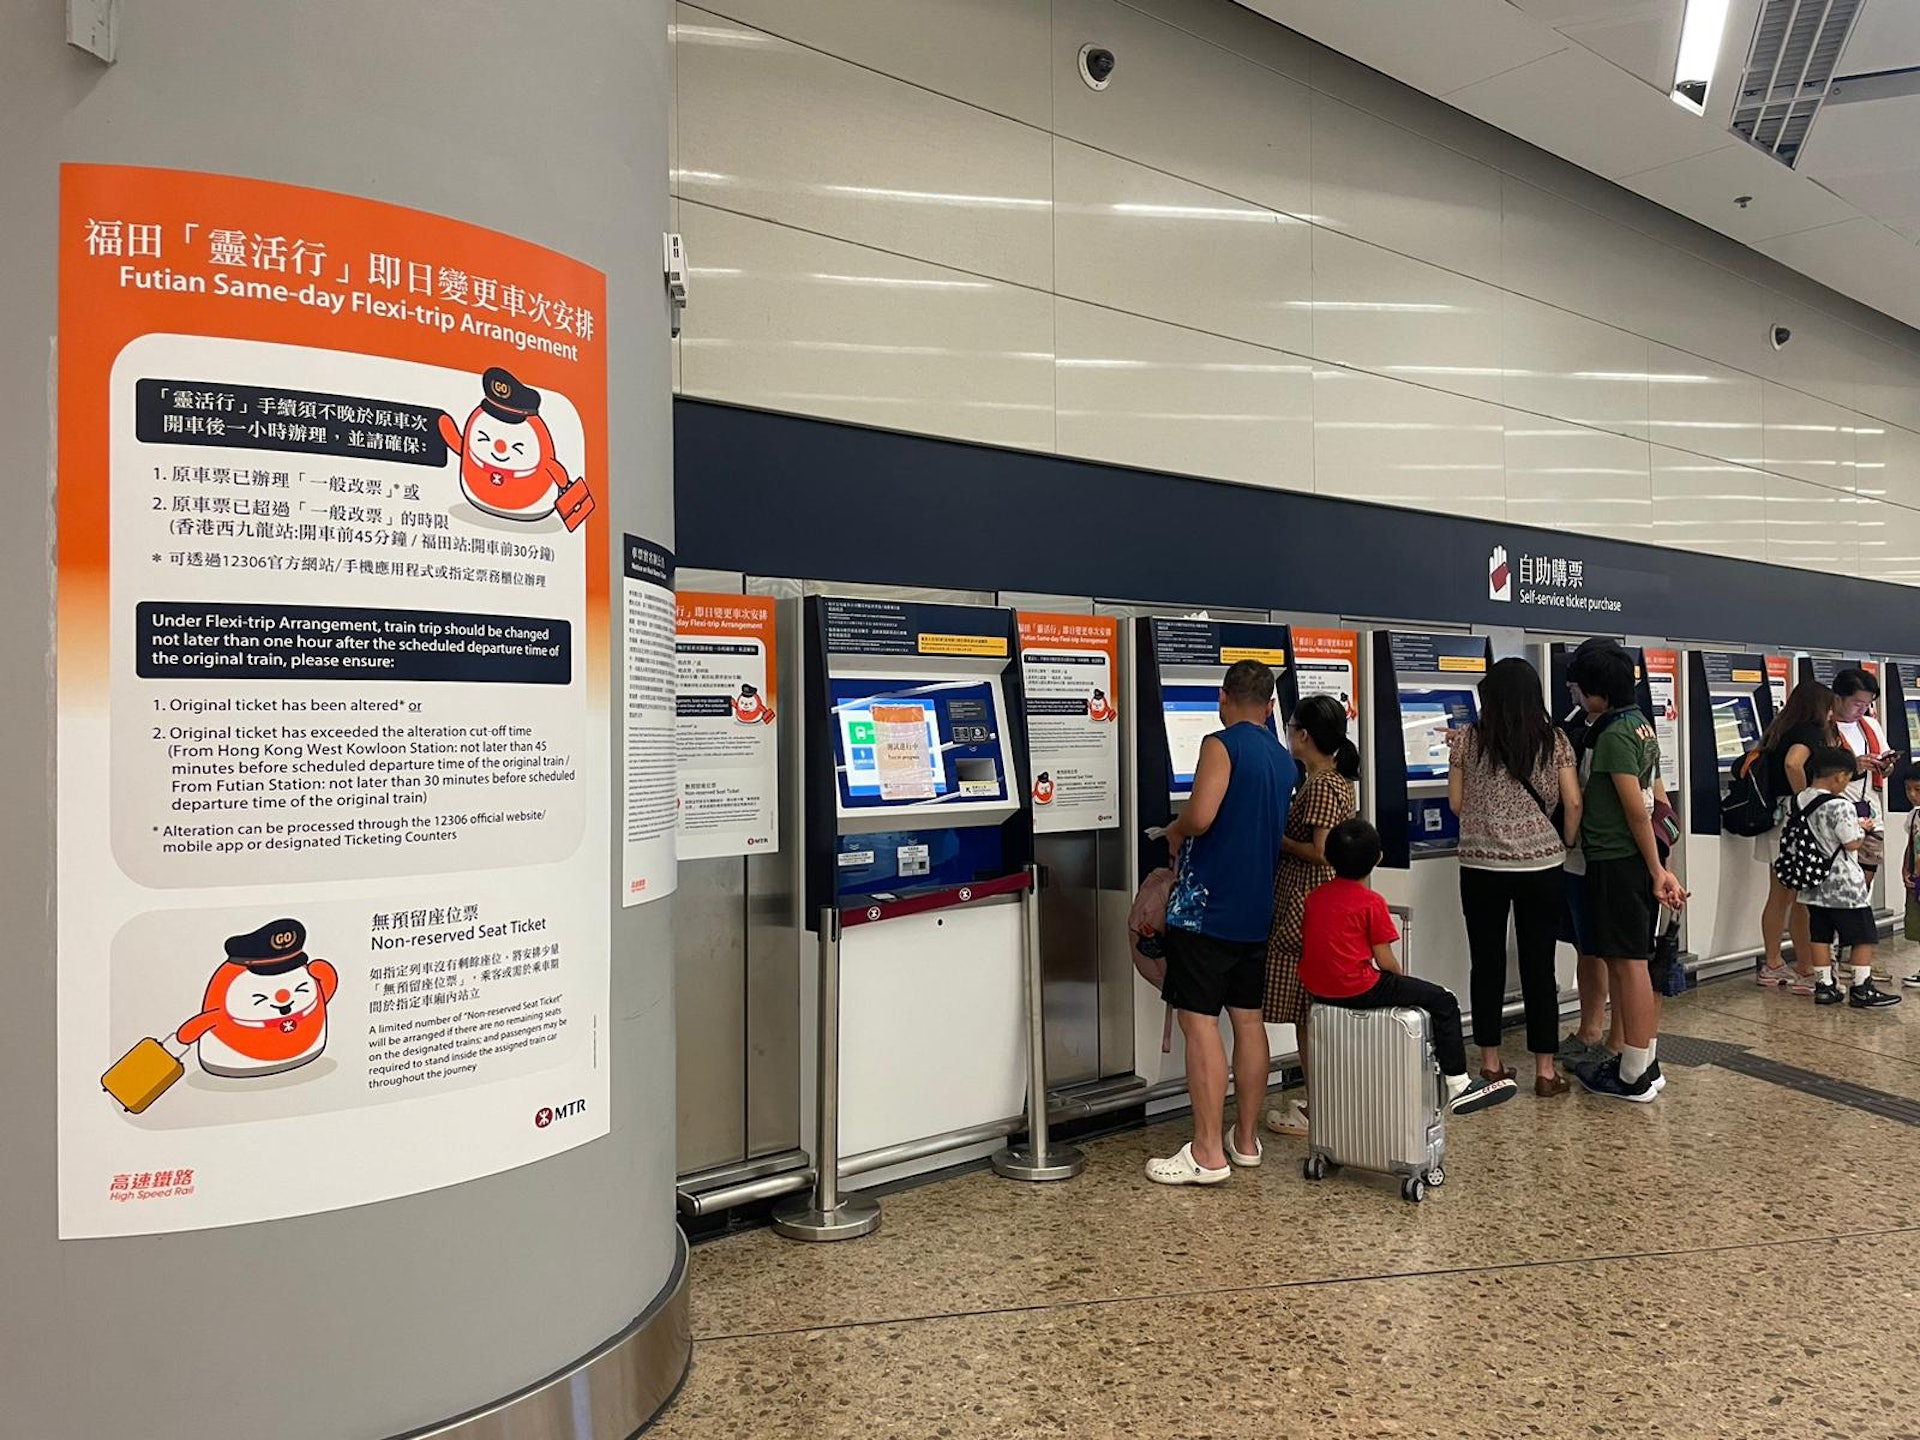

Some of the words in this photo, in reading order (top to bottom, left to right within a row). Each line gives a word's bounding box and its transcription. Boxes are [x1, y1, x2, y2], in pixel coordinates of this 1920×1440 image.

[84, 218, 594, 341] 福田「靈活行」即日變更車次安排
[120, 266, 206, 292] Futian
[214, 274, 345, 314] Same-day
[352, 292, 455, 332] Flexi-trip
[460, 313, 578, 362] Arrangement
[494, 382, 508, 394] GO
[160, 388, 428, 432] 「靈活行」手續須不晚於原車次
[153, 468, 166, 480] 1.
[152, 498, 166, 510] 2.
[172, 496, 449, 530] 原車票已超過「一般改票」的時限
[1519, 554, 1583, 588] 自助購票
[1520, 589, 1565, 607] Self-service
[1566, 594, 1587, 608] ticket
[1588, 597, 1622, 612] purchase
[153, 614, 201, 628] Under
[206, 615, 275, 634] Flexi-trip
[279, 616, 381, 635] Arrangement,
[385, 619, 416, 633] train
[419, 620, 442, 638] trip
[445, 621, 485, 636] should
[488, 623, 502, 637] be
[505, 624, 549, 643] changed
[152, 632, 180, 646] not
[184, 632, 218, 646] later
[224, 633, 259, 647] than
[264, 637, 293, 647] one
[297, 634, 332, 648] hour
[336, 635, 370, 649] after
[373, 636, 396, 650] the
[399, 637, 465, 653] scheduled
[467, 639, 523, 658] departure
[525, 641, 547, 656] time
[549, 643, 560, 656] of
[152, 651, 178, 664] the
[182, 652, 243, 669] original
[247, 652, 287, 668] train,
[291, 653, 338, 670] please
[343, 657, 394, 668] ensure:
[154, 699, 165, 710] 1.
[170, 699, 231, 714] Original
[236, 699, 277, 710] ticket
[282, 699, 306, 710] has
[311, 699, 346, 710] been
[409, 702, 422, 712] or
[153, 727, 165, 738] 2.
[170, 727, 231, 742] Original
[236, 726, 277, 738] ticket
[282, 726, 306, 738] has
[311, 726, 378, 738] exceeded
[383, 725, 404, 737] the
[407, 725, 467, 737] alteration
[470, 724, 506, 736] cut-off
[509, 724, 532, 735] time
[168, 745, 213, 758] (From
[218, 745, 259, 759] Hong
[264, 744, 303, 758] Kong
[307, 743, 342, 754] West
[347, 743, 406, 754] Kowloon
[410, 742, 457, 753] Station:
[460, 741, 480, 752] not
[482, 741, 507, 752] later
[510, 740, 533, 751] than
[535, 740, 547, 751] 45
[172, 762, 234, 774] minutes
[239, 761, 288, 773] before
[292, 759, 365, 772] scheduled
[370, 758, 434, 773] departure
[438, 757, 465, 769] time
[468, 757, 479, 768] of
[482, 756, 500, 768] the
[503, 754, 541, 770] original
[544, 754, 564, 765] train
[172, 780, 211, 792] From
[217, 779, 264, 791] Futian
[269, 778, 325, 789] Station:
[330, 776, 353, 788] not
[358, 776, 387, 787] later
[392, 775, 420, 786] than
[425, 774, 440, 785] 30
[443, 773, 489, 785] minutes
[492, 771, 526, 783] before
[529, 769, 575, 782] scheduled
[172, 797, 248, 813] departure
[253, 796, 286, 808] time
[290, 796, 305, 807] of
[309, 795, 332, 807] the
[337, 793, 389, 809] original
[394, 792, 427, 805] train)
[163, 824, 234, 836] Alteration
[238, 826, 262, 834] can
[267, 823, 283, 833] be
[288, 819, 354, 836] processed
[358, 816, 408, 831] through
[412, 815, 430, 826] the
[435, 813, 467, 825] 12306
[470, 811, 503, 823] official
[163, 840, 212, 852] mobile
[217, 842, 243, 854] app
[247, 841, 262, 849] or
[266, 834, 341, 851] designated
[345, 832, 401, 846] Ticketing
[405, 829, 457, 842] Counters
[372, 904, 478, 932] 無預留座位票
[276, 932, 291, 944] GO
[372, 926, 474, 950] Non-reserved
[479, 923, 507, 940] Seat
[510, 918, 546, 934] Ticket
[369, 1036, 385, 1047] will
[403, 1026, 445, 1042] arranged
[455, 1023, 477, 1034] there
[506, 1010, 543, 1025] remaining
[545, 1005, 561, 1017] seats
[379, 1019, 412, 1033] limited
[415, 1015, 450, 1028] number
[384, 1048, 400, 1059] the
[402, 1039, 454, 1056] designated
[483, 1031, 499, 1043] and
[501, 1025, 542, 1042] passengers
[369, 1059, 410, 1076] required
[425, 1052, 450, 1065] stand
[452, 1048, 477, 1061] inside
[495, 1037, 528, 1052] assigned
[530, 1034, 546, 1046] train
[369, 1070, 424, 1088] throughout
[427, 1067, 441, 1078] the
[444, 1062, 477, 1078] journey
[555, 1099, 586, 1121] MTR
[110, 1170, 194, 1190] 高速鐵路
[110, 1190, 134, 1202] High
[137, 1188, 171, 1200] Speed
[174, 1186, 194, 1196] Rail
